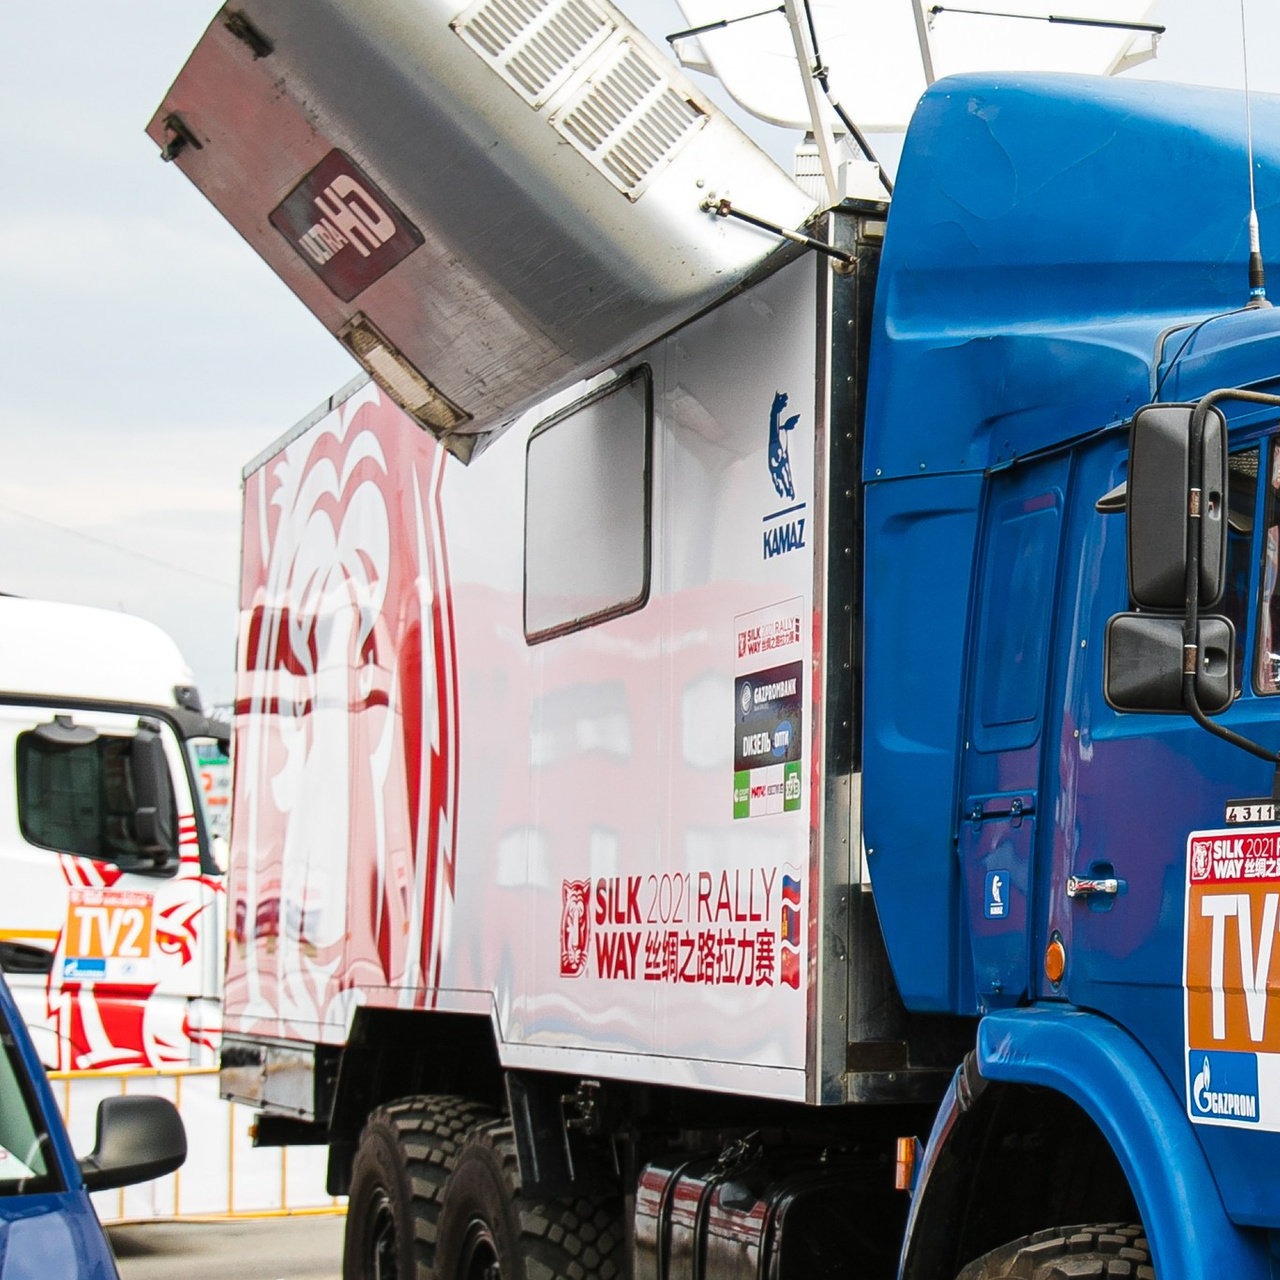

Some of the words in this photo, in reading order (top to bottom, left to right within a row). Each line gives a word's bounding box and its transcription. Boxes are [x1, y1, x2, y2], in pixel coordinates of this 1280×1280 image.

[314, 174, 397, 258] HD
[298, 218, 349, 265] ULTRA
[763, 518, 806, 560] KAMAZ
[747, 628, 761, 642] SILK
[774, 617, 794, 635] RALLY
[747, 642, 761, 656] WAY
[754, 677, 797, 704] GAZPROMBANK
[1228, 806, 1273, 821] 4311
[1213, 839, 1244, 859] SILK
[1246, 837, 1274, 857] 2021
[1213, 859, 1245, 880] WAY
[595, 875, 643, 926] SILK
[647, 872, 691, 924] 2021
[697, 866, 777, 923] RALLY
[73, 906, 144, 957] TV2
[595, 931, 643, 980] WAY
[644, 927, 776, 987] 丝绸之路拉力赛
[1211, 1093, 1256, 1118] GAZPROM
